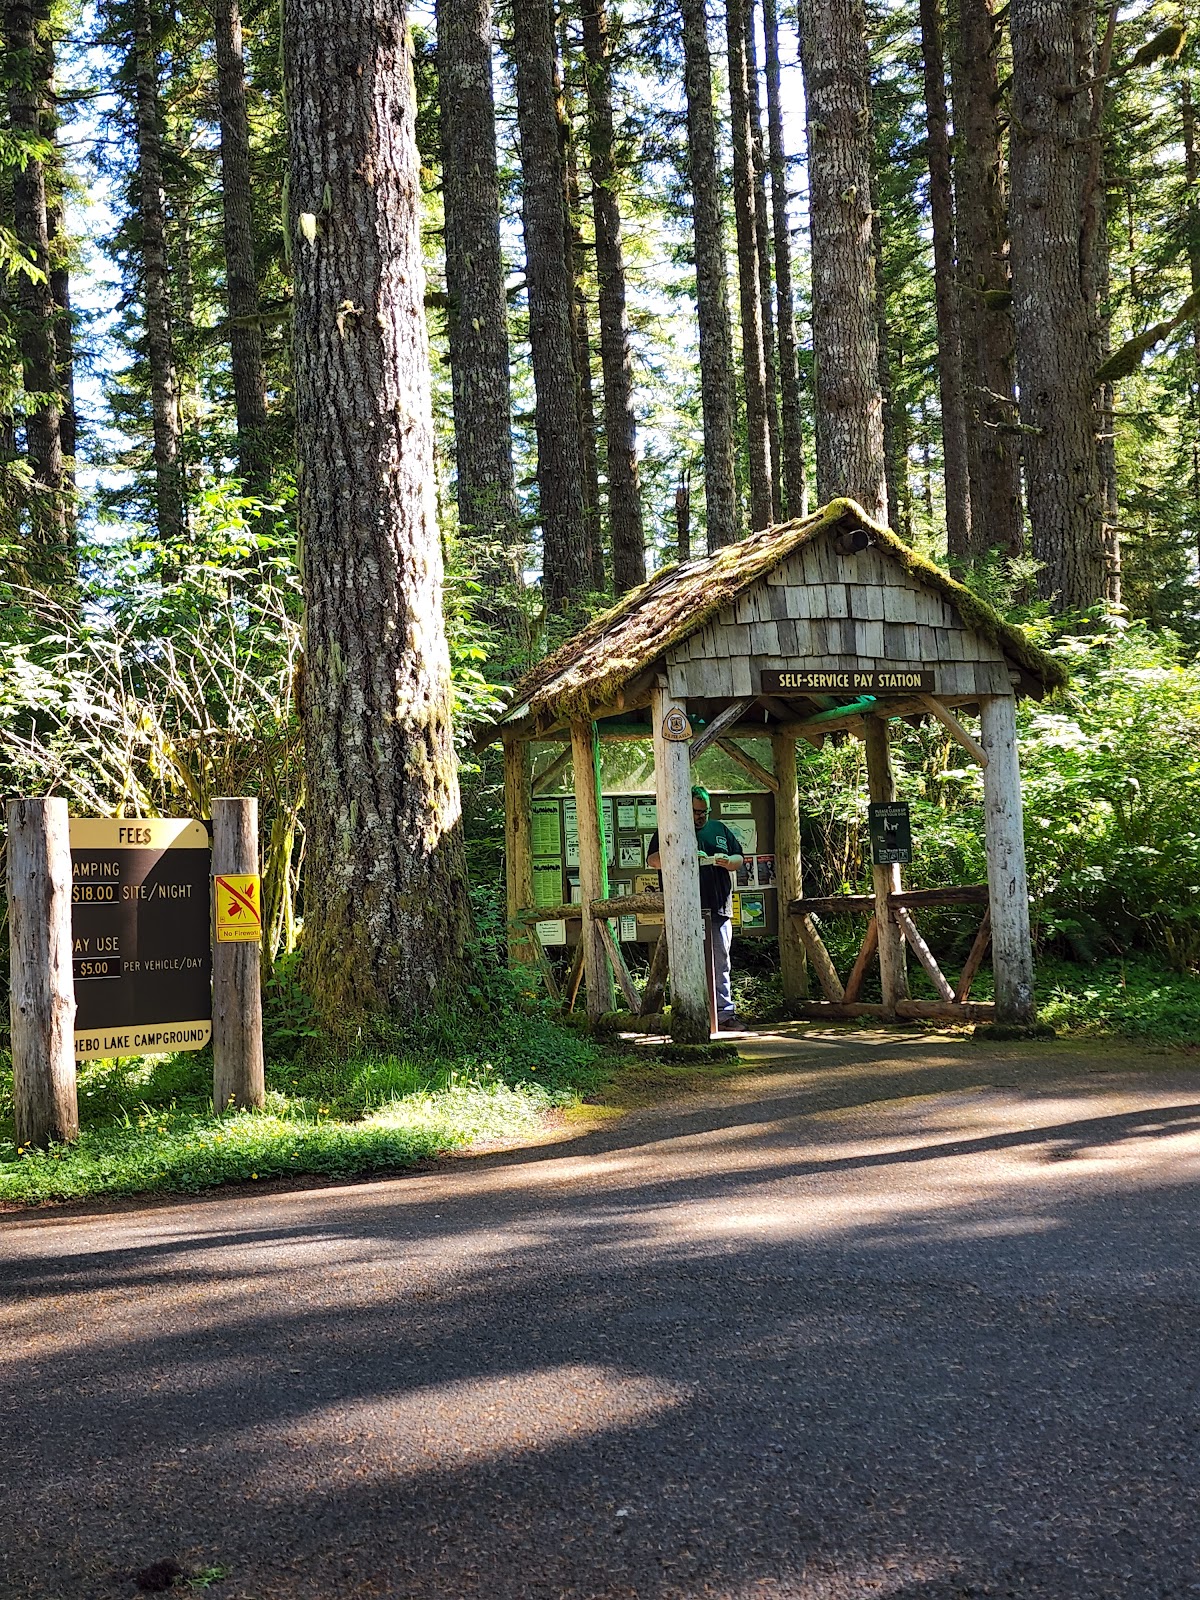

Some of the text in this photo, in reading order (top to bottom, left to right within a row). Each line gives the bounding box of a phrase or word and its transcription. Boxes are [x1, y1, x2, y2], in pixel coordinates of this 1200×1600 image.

[779, 673, 922, 687] SELF-SERVICE PAY STATION
[119, 827, 152, 845] FEES
[72, 862, 120, 877] AMPING
[72, 882, 192, 902] $18.00 SITE/NIGHT
[71, 936, 120, 952] AY USE
[80, 957, 204, 976] $5.00 PER VEHICLE/DAY
[104, 1035, 130, 1049] LAKE
[134, 1029, 204, 1047] CAMPGROUND
